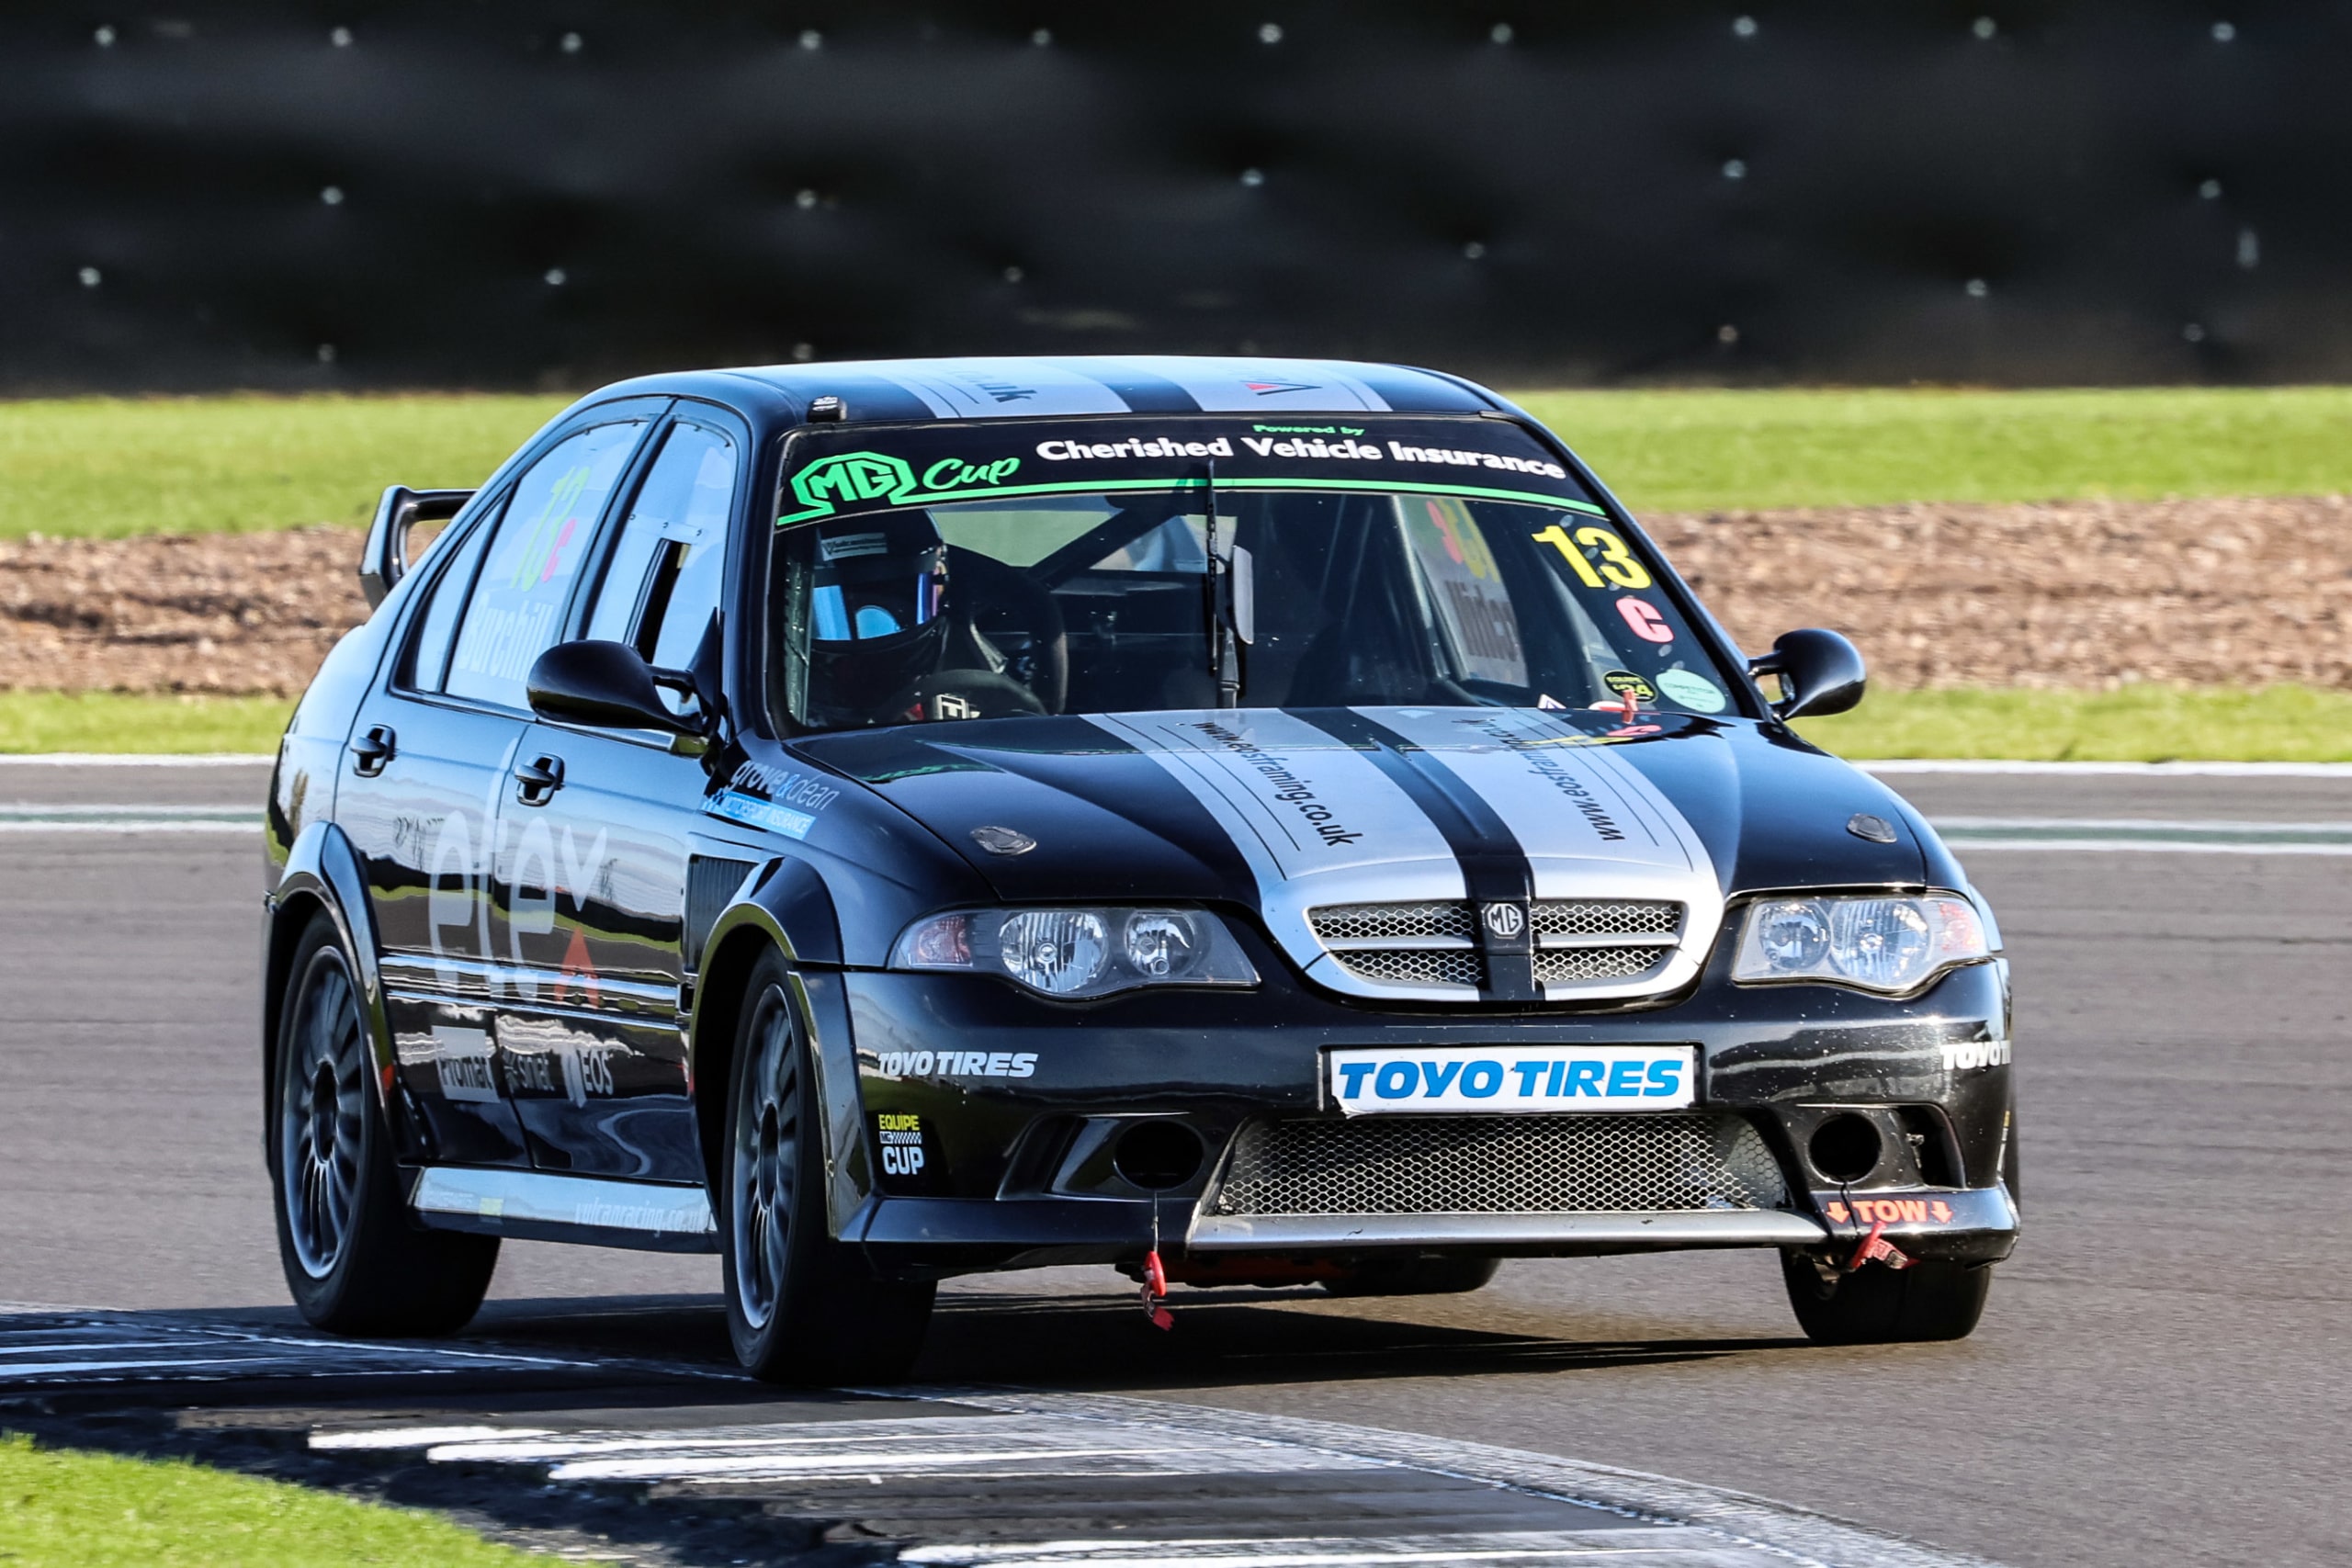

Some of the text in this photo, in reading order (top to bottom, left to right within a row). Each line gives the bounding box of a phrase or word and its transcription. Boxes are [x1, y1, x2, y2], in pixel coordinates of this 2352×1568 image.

[1252, 424, 1365, 436] Powered by
[1035, 436, 1566, 479] Cherished Vehicle Insurance
[805, 457, 1021, 503] MG Cup
[1531, 525, 1652, 590] 13
[1615, 597, 1675, 643] C
[1191, 721, 1363, 847] www.eosframing.co.uk
[1491, 904, 1521, 935] MG
[878, 1050, 1039, 1078] TOYO TIRES
[1339, 1059, 1683, 1100] TOYO TIRES
[878, 1113, 921, 1131] EQUIPE
[881, 1145, 925, 1175] CUP
[1852, 1200, 1928, 1223] TOW
